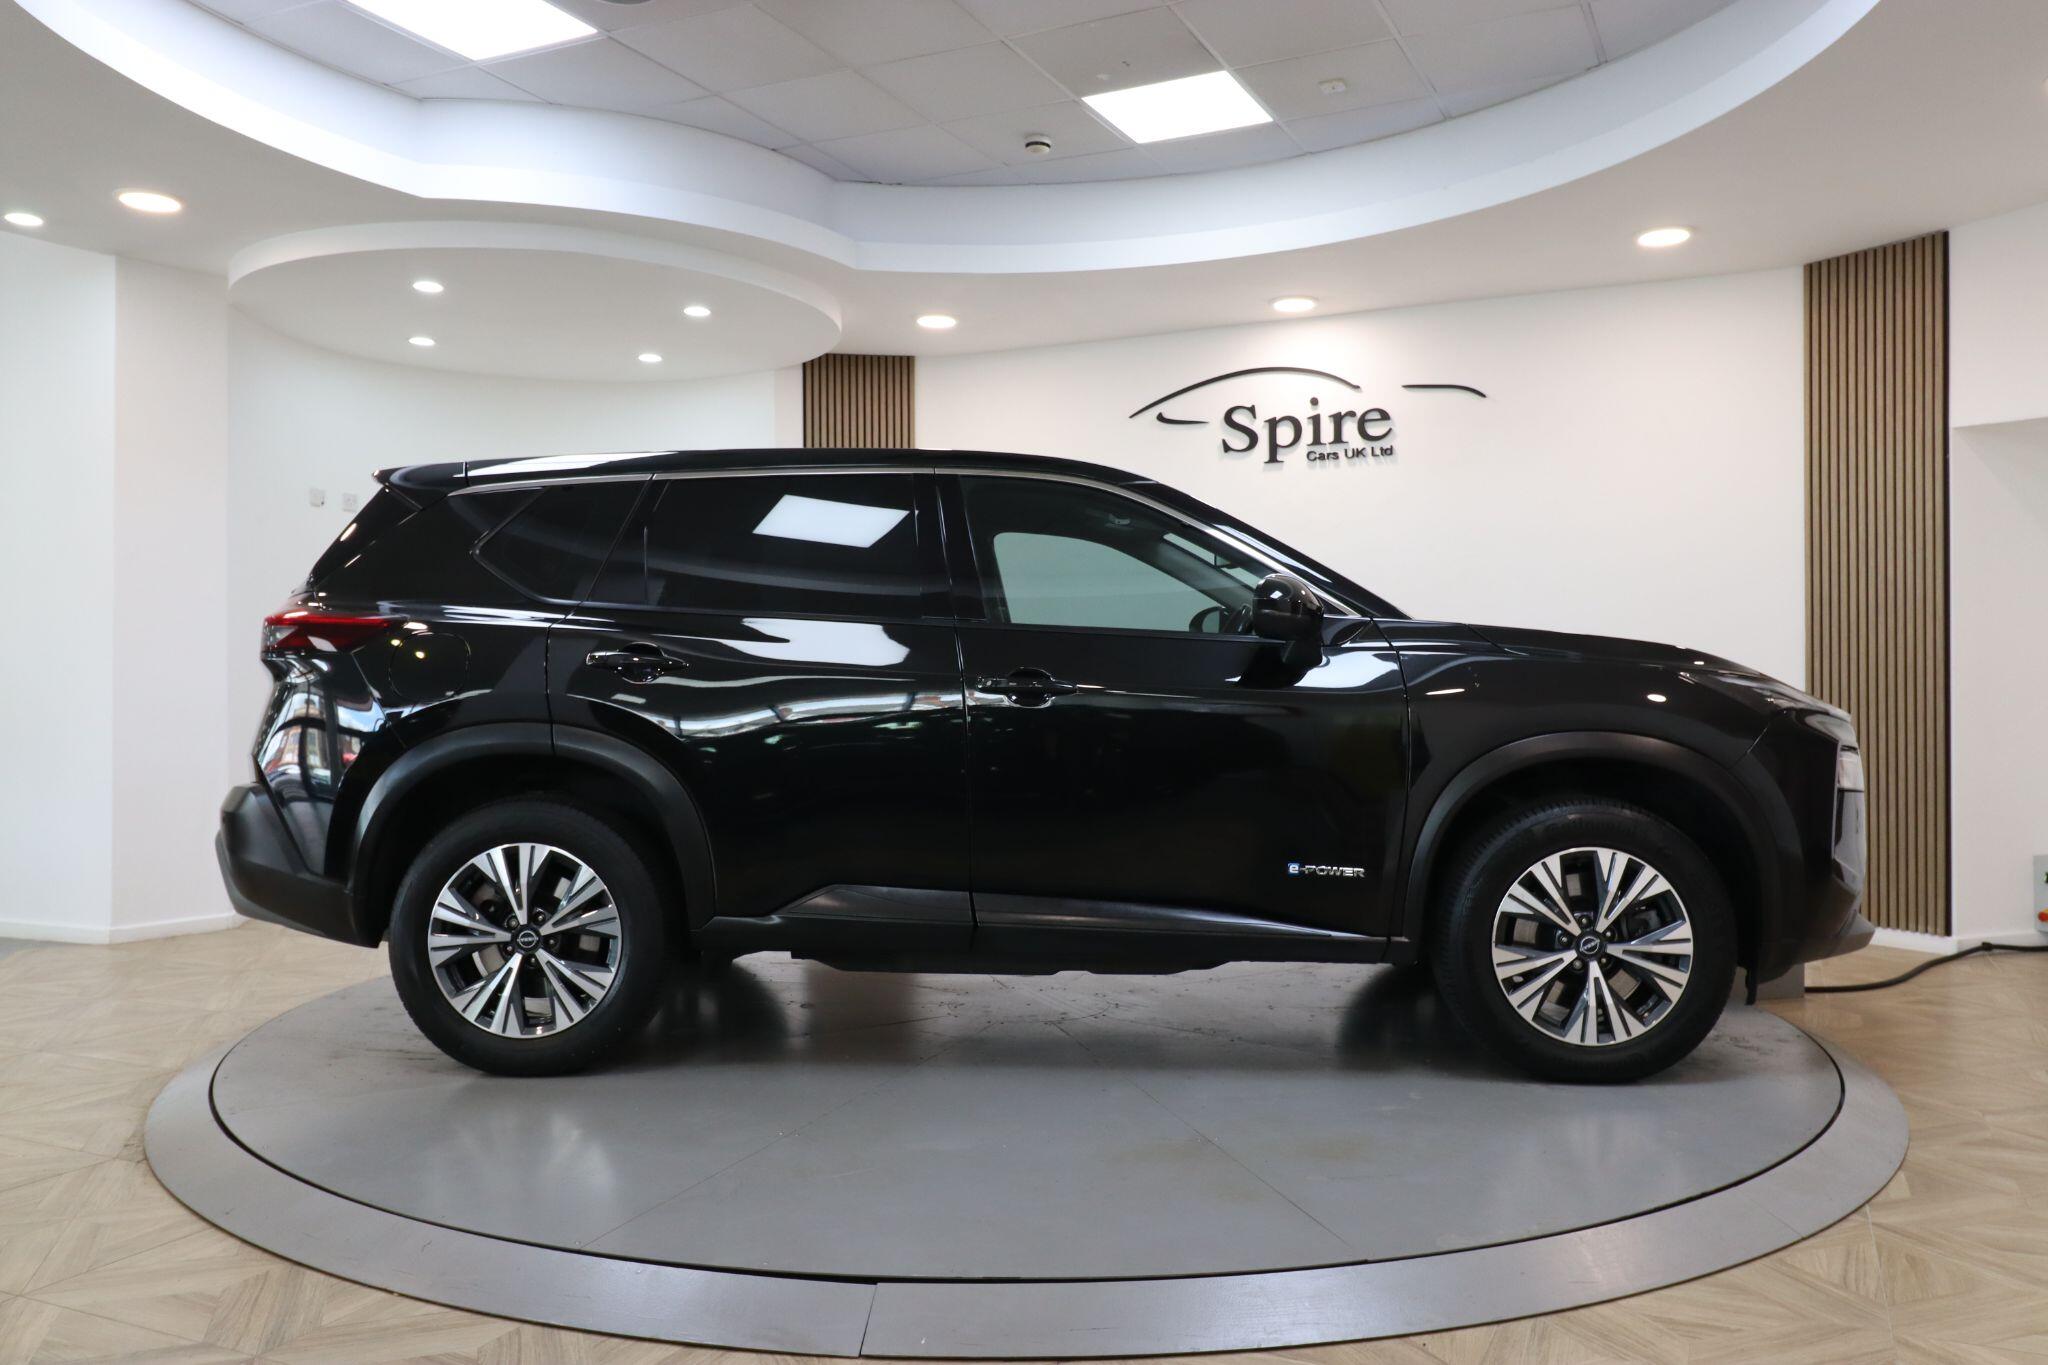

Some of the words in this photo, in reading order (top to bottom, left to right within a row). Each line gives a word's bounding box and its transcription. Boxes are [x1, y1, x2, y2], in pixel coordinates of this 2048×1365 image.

[1222, 397, 1392, 464] Spire
[1306, 450, 1339, 462] Cars
[1344, 447, 1367, 459] UK
[1371, 445, 1393, 457] Ltd
